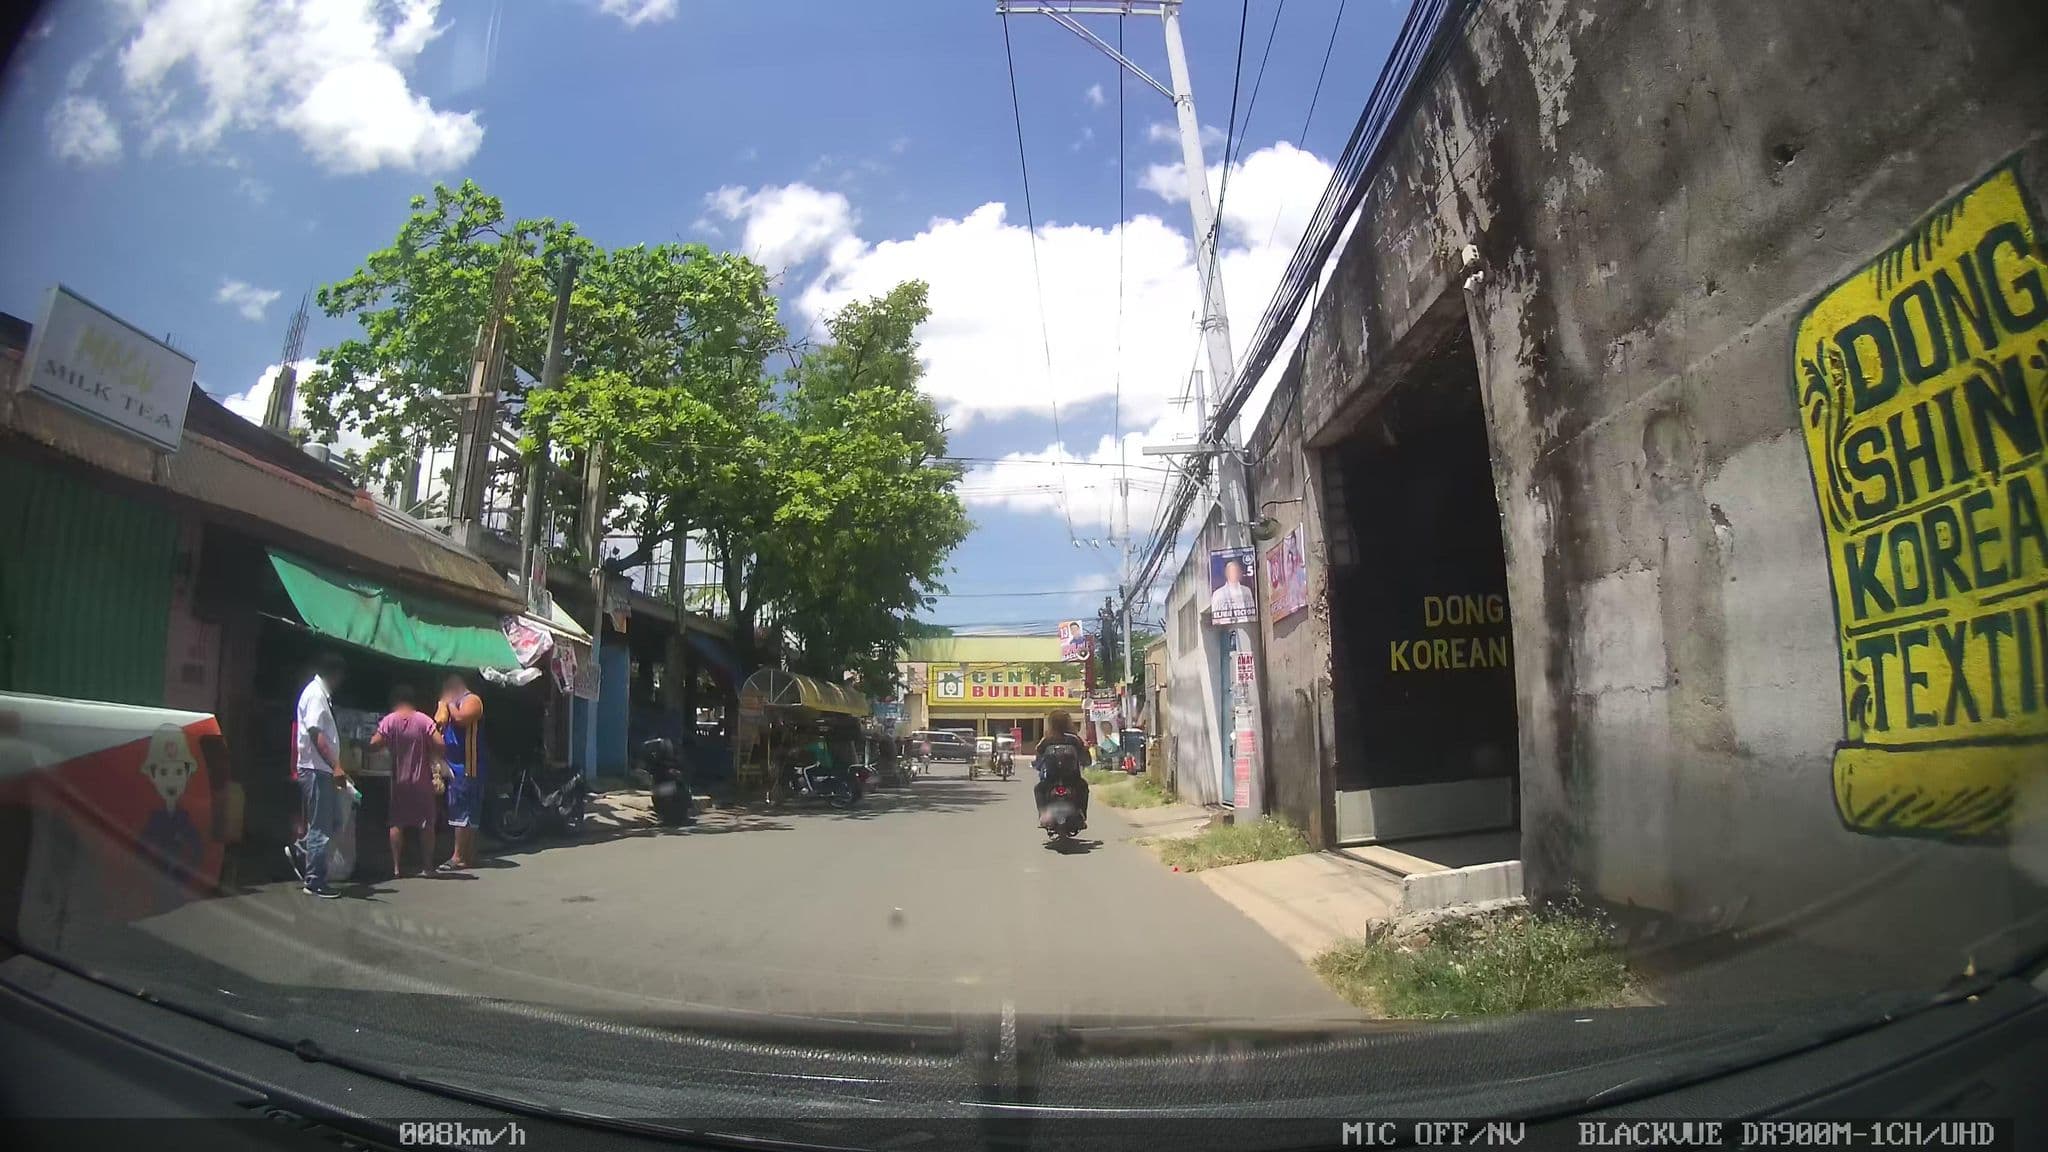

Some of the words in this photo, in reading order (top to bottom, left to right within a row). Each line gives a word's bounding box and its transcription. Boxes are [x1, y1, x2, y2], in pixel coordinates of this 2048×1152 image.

[1834, 221, 2048, 414] DONG
[44, 358, 113, 402] MILK
[120, 390, 172, 430] TEA
[1844, 354, 2043, 521] SHIN
[1424, 594, 1504, 627] DONG
[1845, 476, 2048, 620] KOREA
[1390, 636, 1508, 671] KOREAN
[1856, 600, 2048, 731] TEXTI
